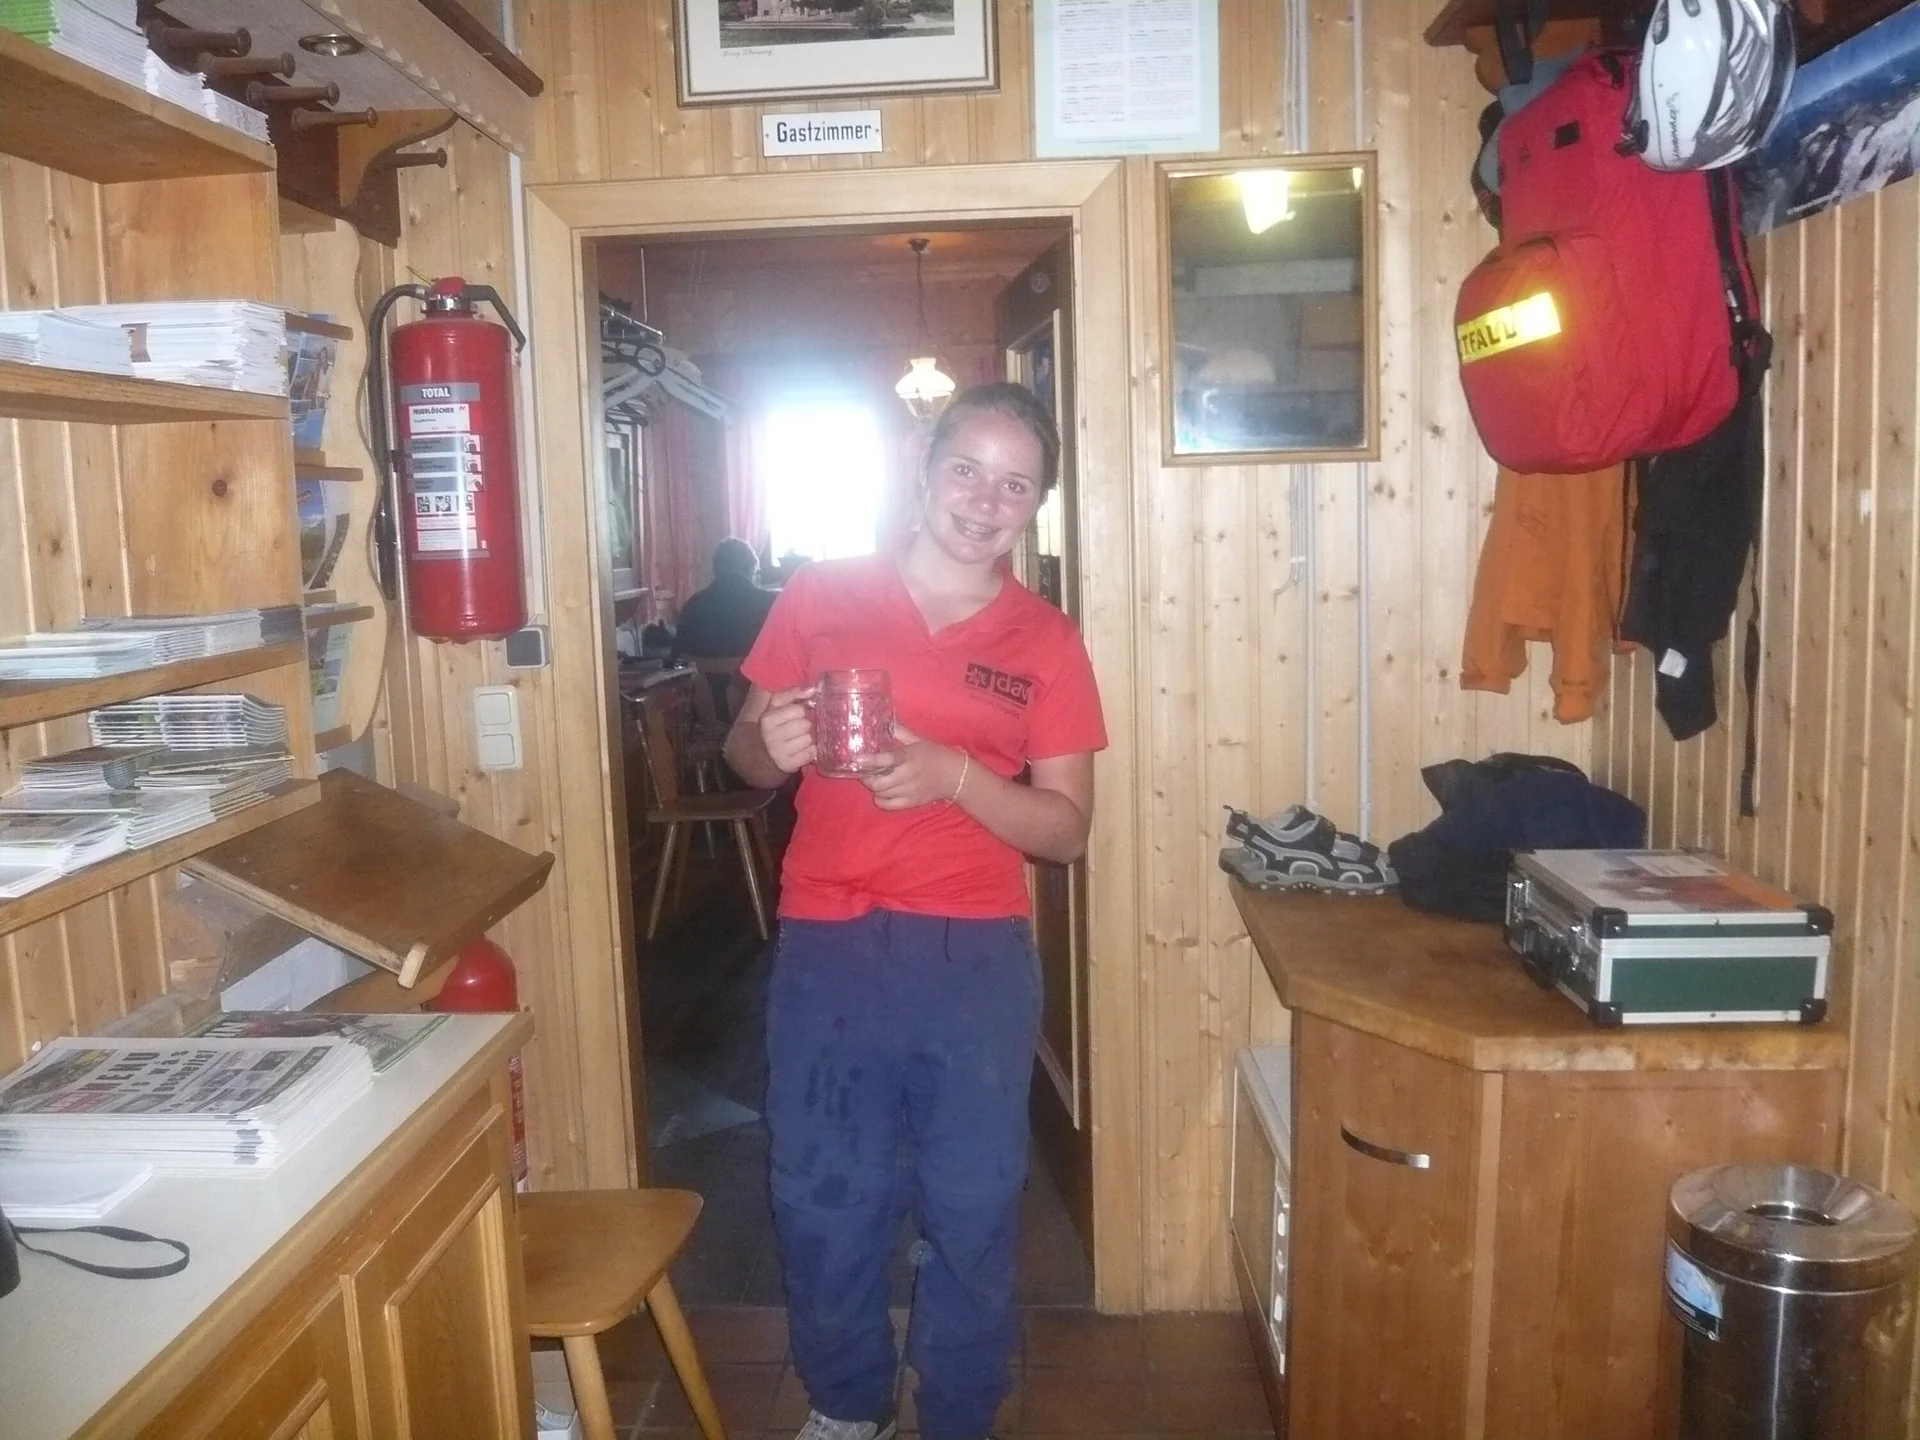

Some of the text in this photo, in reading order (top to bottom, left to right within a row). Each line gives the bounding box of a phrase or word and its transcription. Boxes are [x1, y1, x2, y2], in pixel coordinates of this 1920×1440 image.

[776, 120, 872, 143] Gastzimmer
[421, 387, 450, 398] TOTAL
[412, 406, 454, 415] FEUERLÖSCHER
[445, 495, 452, 503] B
[466, 495, 473, 503] C
